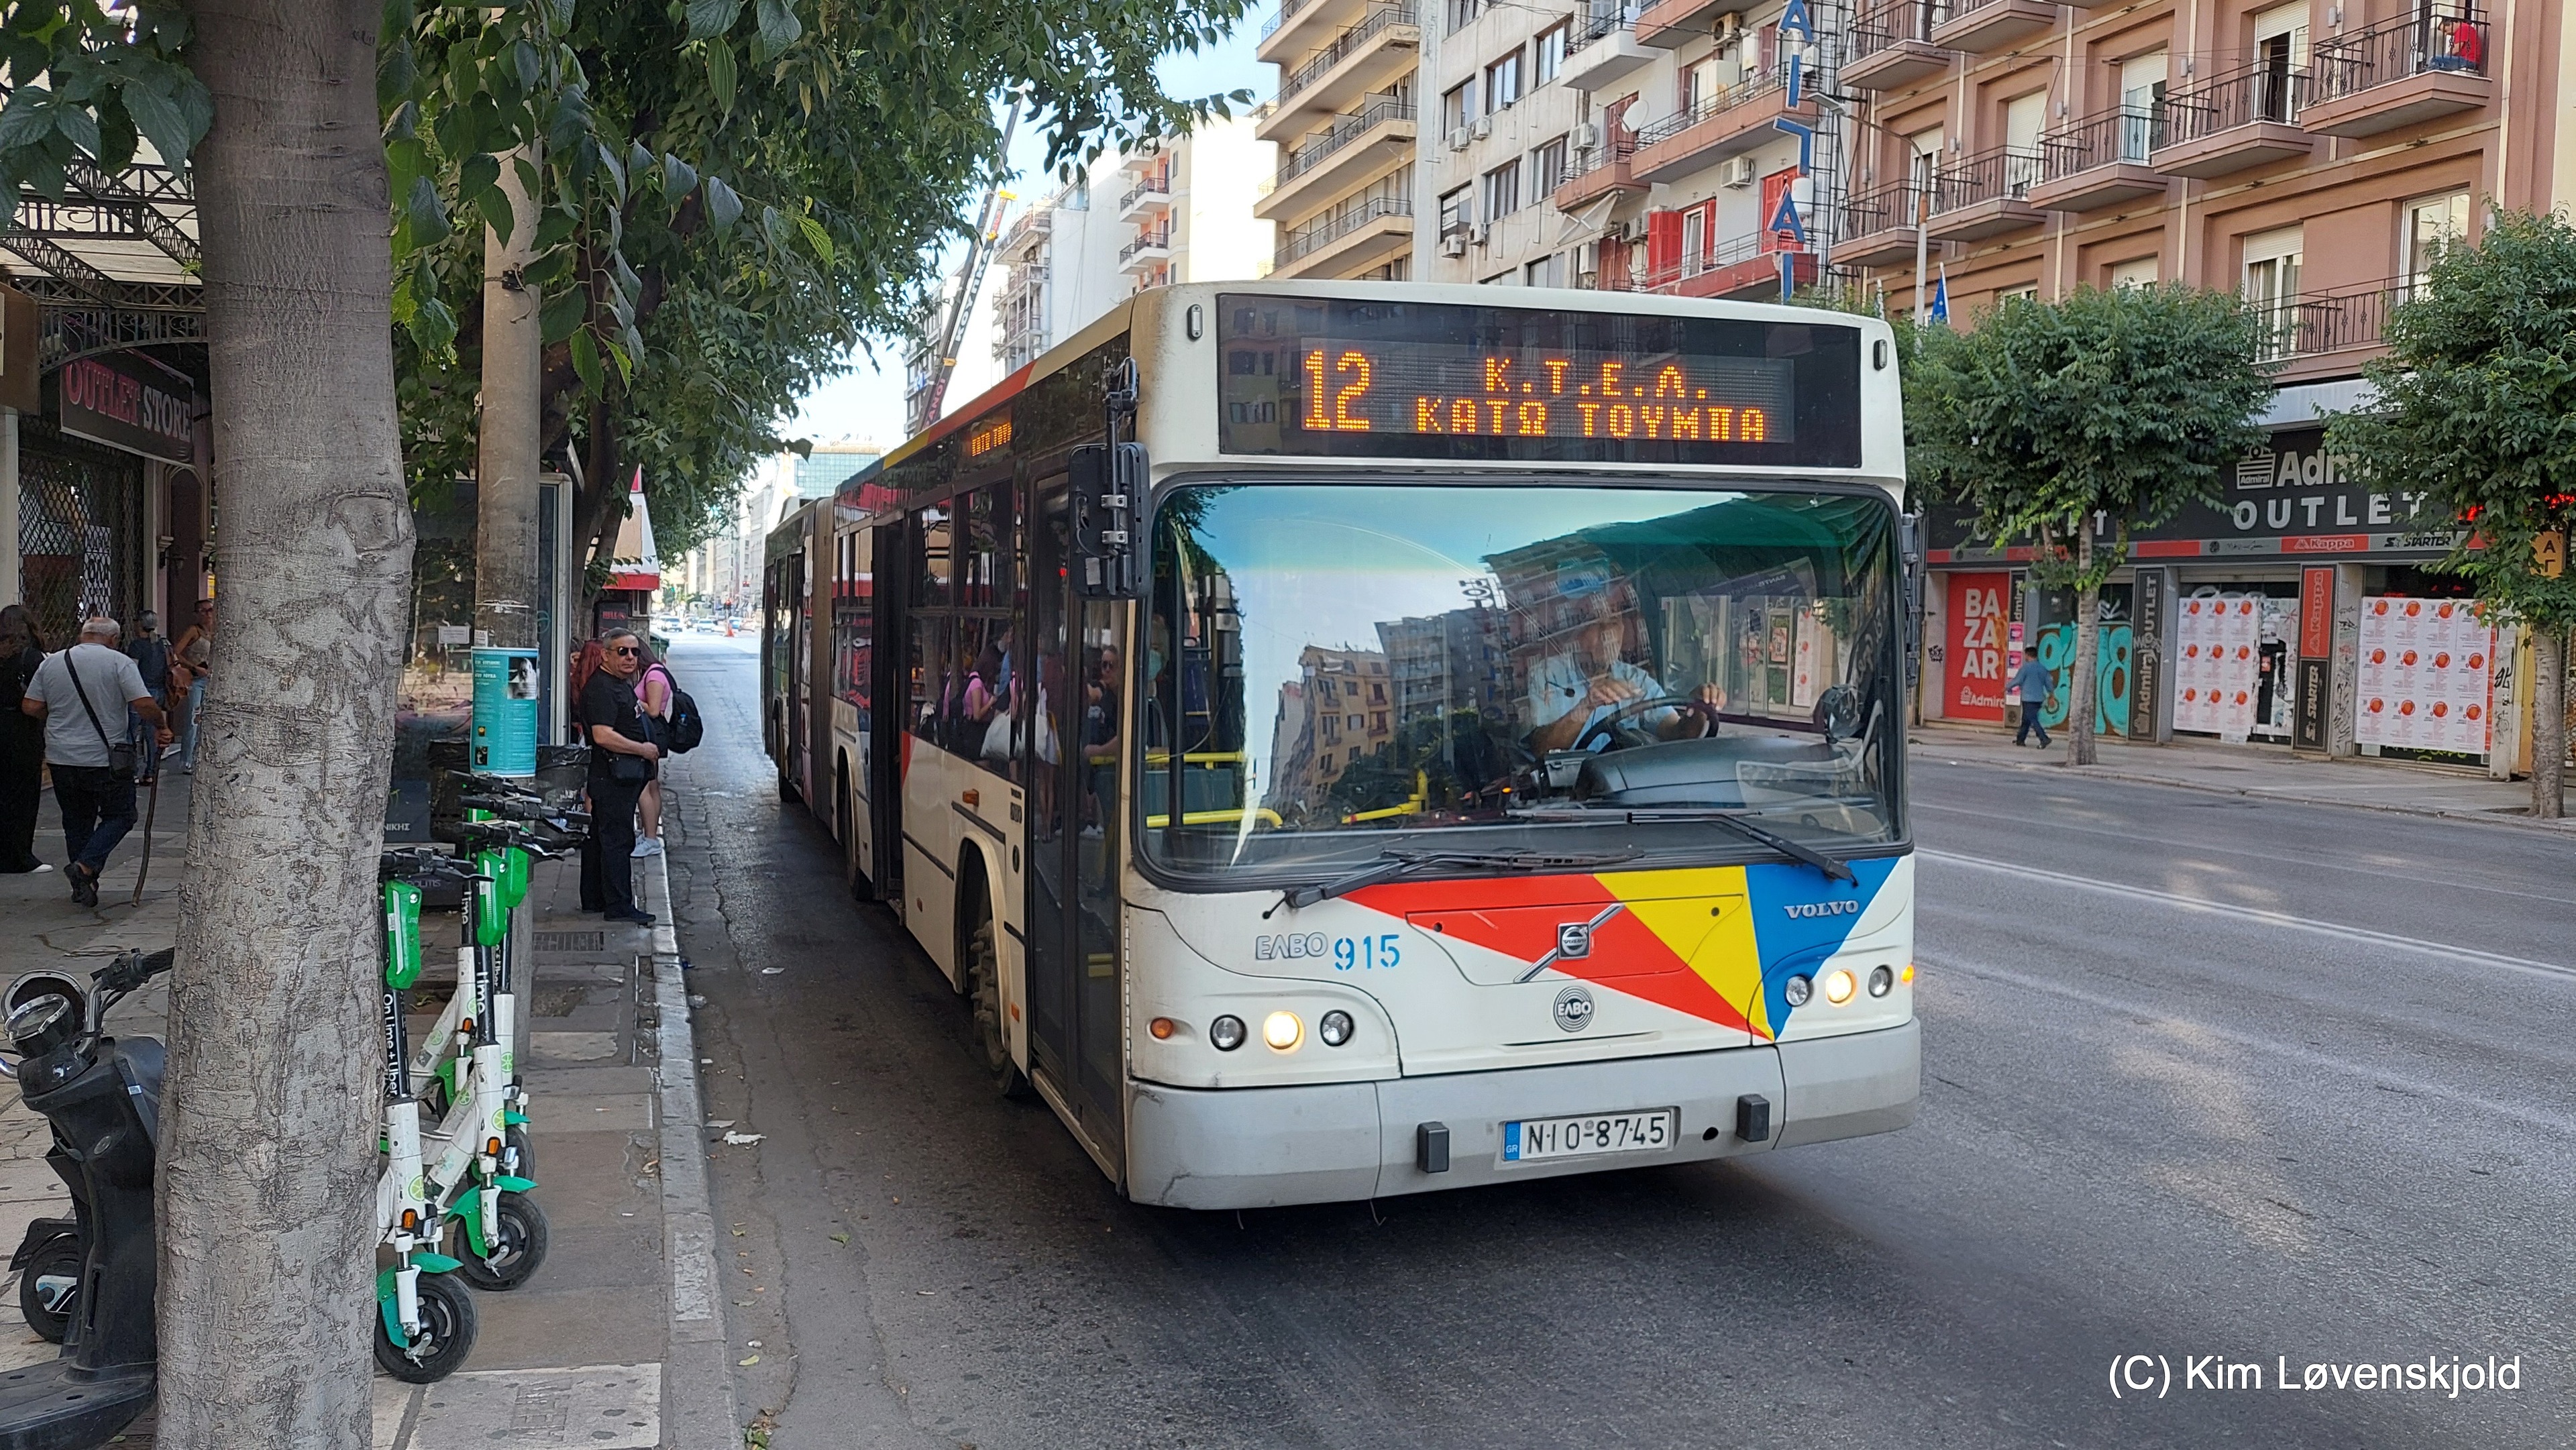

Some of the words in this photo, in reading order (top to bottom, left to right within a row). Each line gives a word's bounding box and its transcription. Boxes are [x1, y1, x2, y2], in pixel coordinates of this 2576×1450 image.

[66, 358, 141, 427] OUTLET
[143, 384, 192, 443] STORE
[1305, 349, 1371, 430] 12
[1415, 396, 1547, 437] ΚΑΤΩ
[1577, 402, 1766, 443] ΤΟΥΜΠΑ
[2233, 490, 2429, 531] OUTLET
[2309, 537, 2355, 549] Kappa
[2403, 536, 2452, 547] STARTER
[1965, 588, 2001, 618] BA
[2014, 579, 2024, 622] dmirl
[2143, 575, 2157, 645] OUTLET
[2310, 571, 2324, 632] Kappa
[1963, 618, 2000, 649] ZA
[1962, 649, 1999, 680] AR
[1970, 693, 2005, 709] Admira
[2308, 665, 2318, 720] STARTER
[1783, 899, 1860, 919] VOLVO
[1334, 934, 1401, 971] 915
[383, 993, 394, 1015] On
[384, 1016, 395, 1050] Lime
[388, 1062, 399, 1096] Uber
[1505, 1143, 1518, 1154] GR
